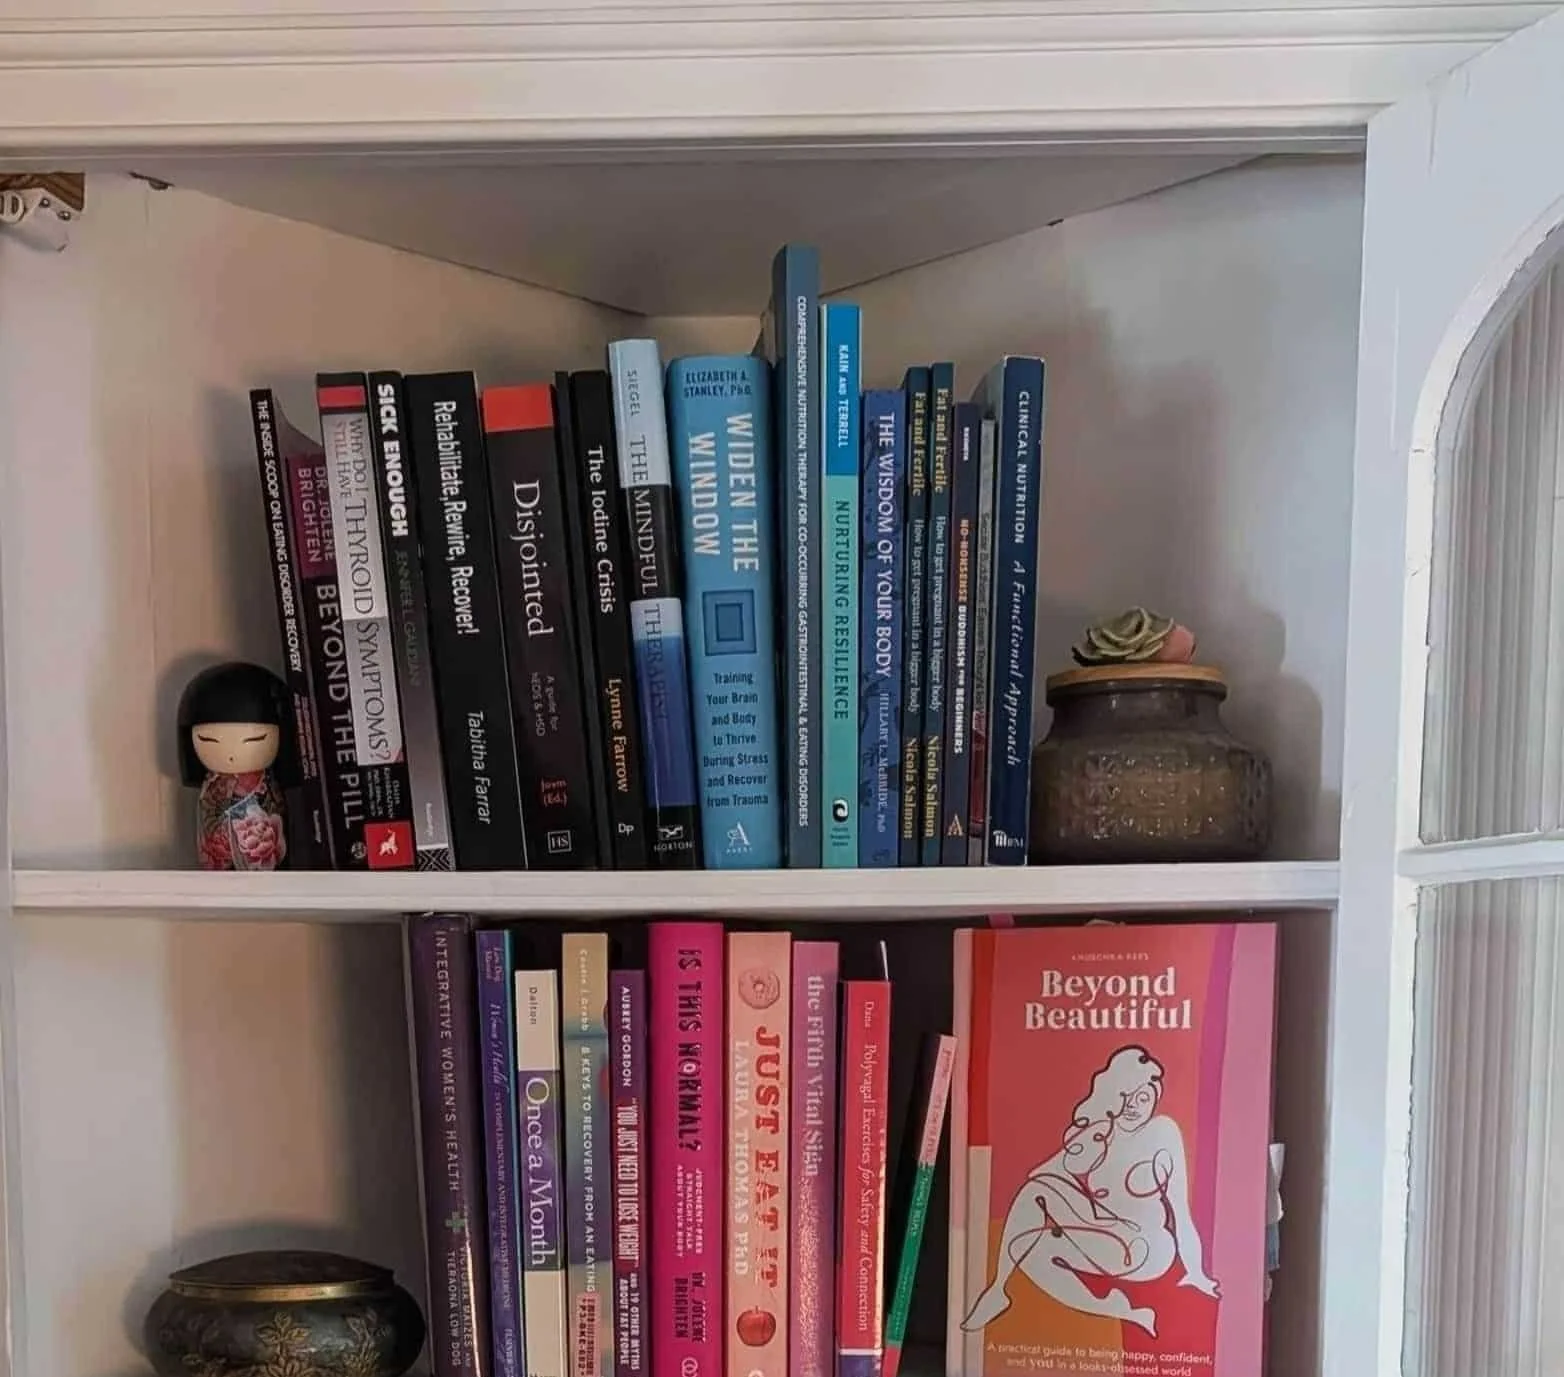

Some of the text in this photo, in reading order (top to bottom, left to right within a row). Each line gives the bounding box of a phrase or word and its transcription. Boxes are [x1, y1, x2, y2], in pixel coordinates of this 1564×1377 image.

[797, 295, 807, 386] COMPREHENSIVE
[377, 384, 408, 537] SICK ENOUGH
[630, 435, 648, 484] THE
[797, 389, 808, 450] NUTRITION
[934, 388, 949, 493] Fat and Fertile
[298, 468, 320, 561] BRIGHTEN
[689, 431, 721, 556] WINDOW
[726, 412, 759, 573] WIDEN THE
[797, 453, 807, 500] THERAPY
[797, 503, 807, 524] FOR
[256, 400, 302, 672] THE INSIDE SCOOP ON EATING DISORDER RECOVERY
[344, 498, 374, 614] THYROID
[510, 480, 554, 637] Disjointed
[587, 445, 616, 613] The Iodine Crisis
[633, 490, 658, 594] MINDFUL
[797, 526, 808, 609] CO-OCCURRING
[875, 412, 895, 678] THE WISDOM OF YOUR BODY
[1004, 391, 1029, 766] CLINICAL NUTRITION A Functional Approach
[450, 566, 479, 635] Recover!
[833, 500, 850, 720] NURTURING RESILIENCE
[316, 585, 364, 829] BEYOND THE PILL
[357, 622, 391, 760] SYMPTOMS?
[798, 610, 808, 714] GASTROINTESTINAL
[605, 679, 628, 792] Lynne Farrow
[798, 727, 808, 766] EATING
[925, 736, 939, 836] Nicola Salmon
[799, 768, 808, 826] DISORDERS
[807, 976, 824, 1010] the
[1025, 998, 1192, 1030] Beautiful
[1041, 967, 1175, 1006] Beyond
[435, 931, 460, 1191] INTEGRATIVE WOMEN'S HEALTH
[678, 949, 703, 1151] IS THIS NORMAL?
[807, 1016, 825, 1068] Fifth
[617, 1127, 638, 1152] JUST
[806, 1074, 825, 1125] Vital
[526, 1077, 555, 1266] Once a Month
[617, 1154, 638, 1180] NEED
[618, 1183, 638, 1196] TO
[734, 1041, 749, 1276] LAURA THOMAS PhD
[755, 1026, 780, 1288] JUST EAT IT
[804, 1129, 823, 1176] Sign
[858, 1044, 877, 1331] Polyvagal Exercises for Safety and Connection
[618, 1198, 638, 1224] LOSE
